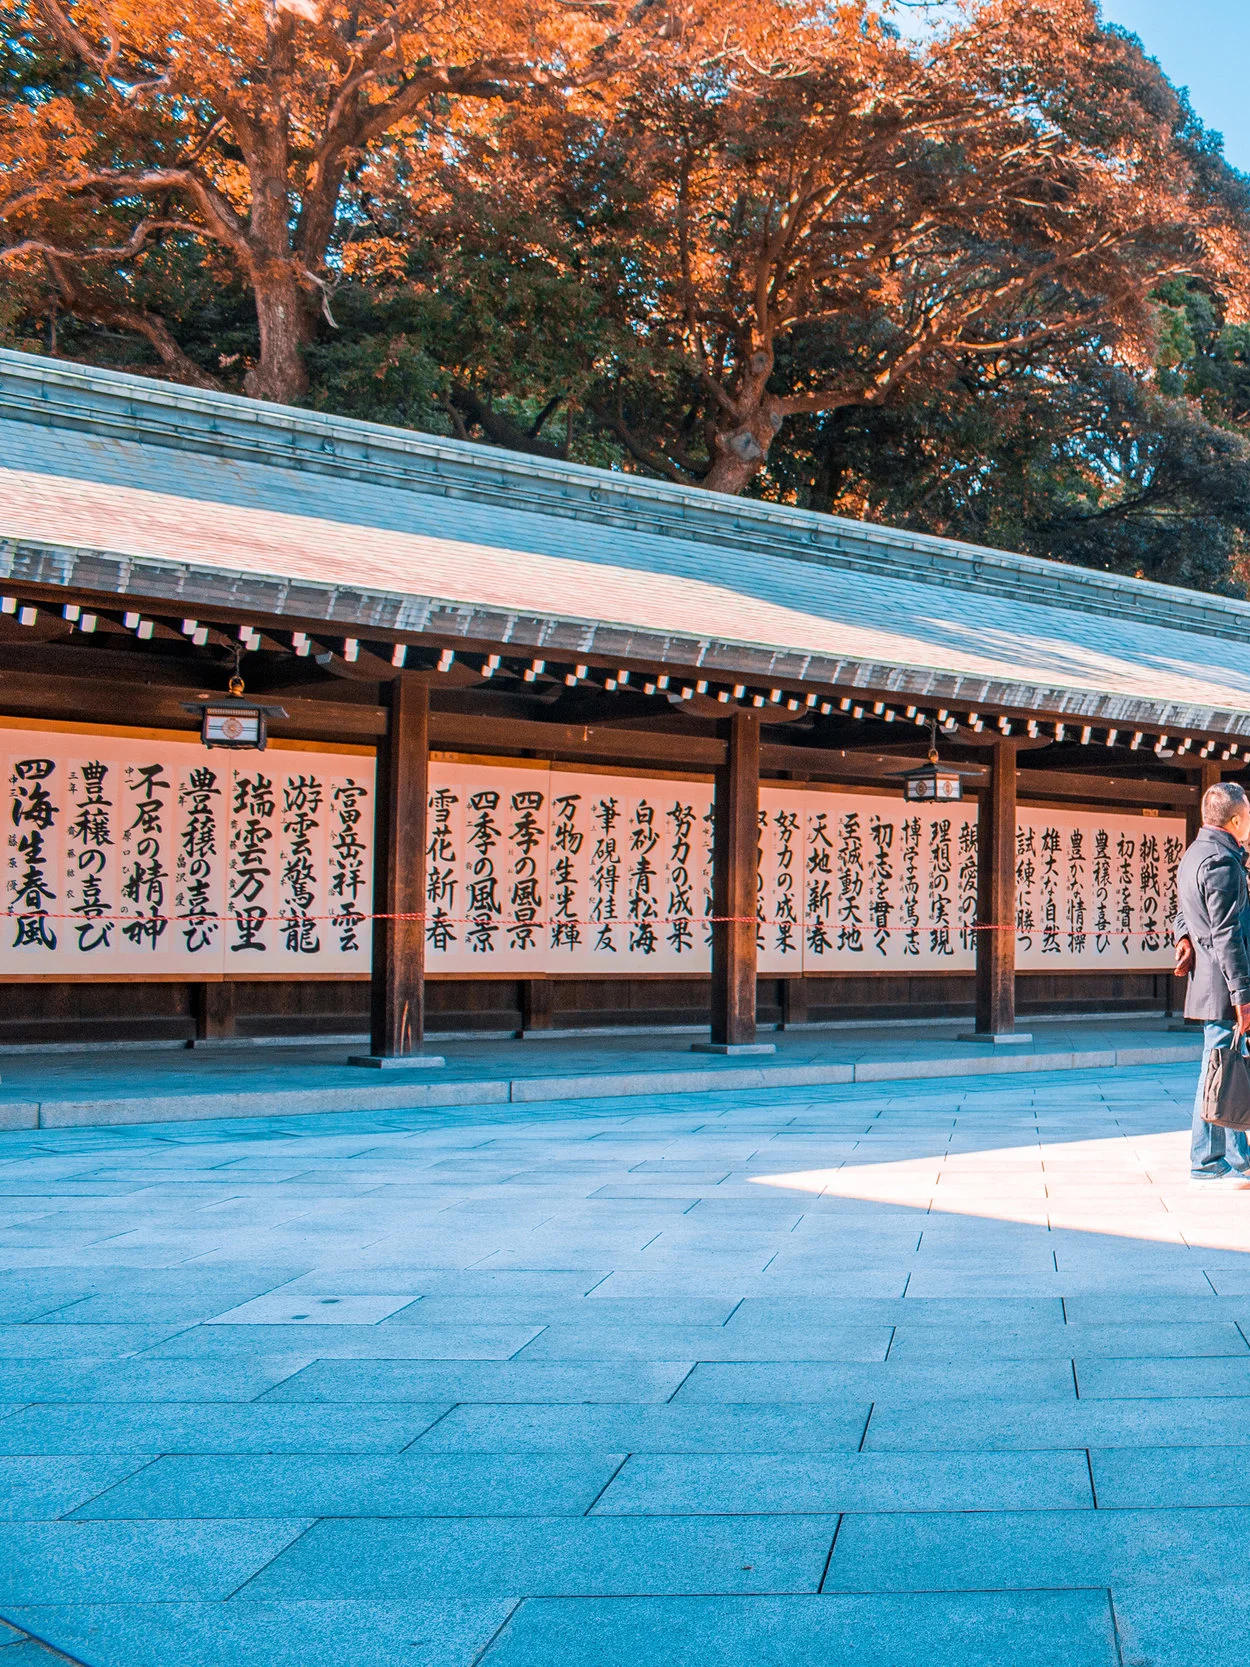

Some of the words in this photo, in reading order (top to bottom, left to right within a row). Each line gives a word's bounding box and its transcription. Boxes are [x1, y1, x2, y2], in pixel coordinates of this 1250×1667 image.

[8, 774, 18, 797] 中三
[68, 772, 78, 794] 三年
[124, 766, 135, 784] 中一
[177, 782, 188, 807] 三年
[12, 759, 60, 950] 四海生春風
[71, 760, 115, 951] 豊穣の喜び
[122, 764, 170, 951] 不屈の精神
[177, 767, 221, 952] 豊穣の喜び
[231, 773, 275, 951] 瑞雲万里
[280, 775, 323, 953] 游雲驚龍
[332, 779, 368, 952] 富岳祥雲
[425, 788, 459, 952] 雪花新春
[467, 791, 502, 952] 四季の風景
[506, 791, 544, 950] 四季の風景
[550, 794, 583, 952] 万物生光輝
[592, 797, 621, 952] 筆硯得佳友
[628, 799, 660, 955] 白砂青松海
[666, 801, 696, 953] 努力の成果
[774, 810, 800, 953] 努力の成果
[807, 813, 833, 955] 天地新春
[837, 812, 863, 951] 至誠動天地
[869, 815, 894, 956] 初志を貫く
[901, 816, 921, 955] 博学而篤志
[929, 819, 954, 955] 理想の実現
[958, 821, 979, 951] 親愛の情
[1015, 825, 1036, 951] 試練に勝つ
[1041, 827, 1062, 953] 雄大な自然
[1067, 828, 1087, 953] 豊かな情操
[1116, 832, 1135, 954] 初志を貫く
[1140, 834, 1160, 951] 挑戦の志
